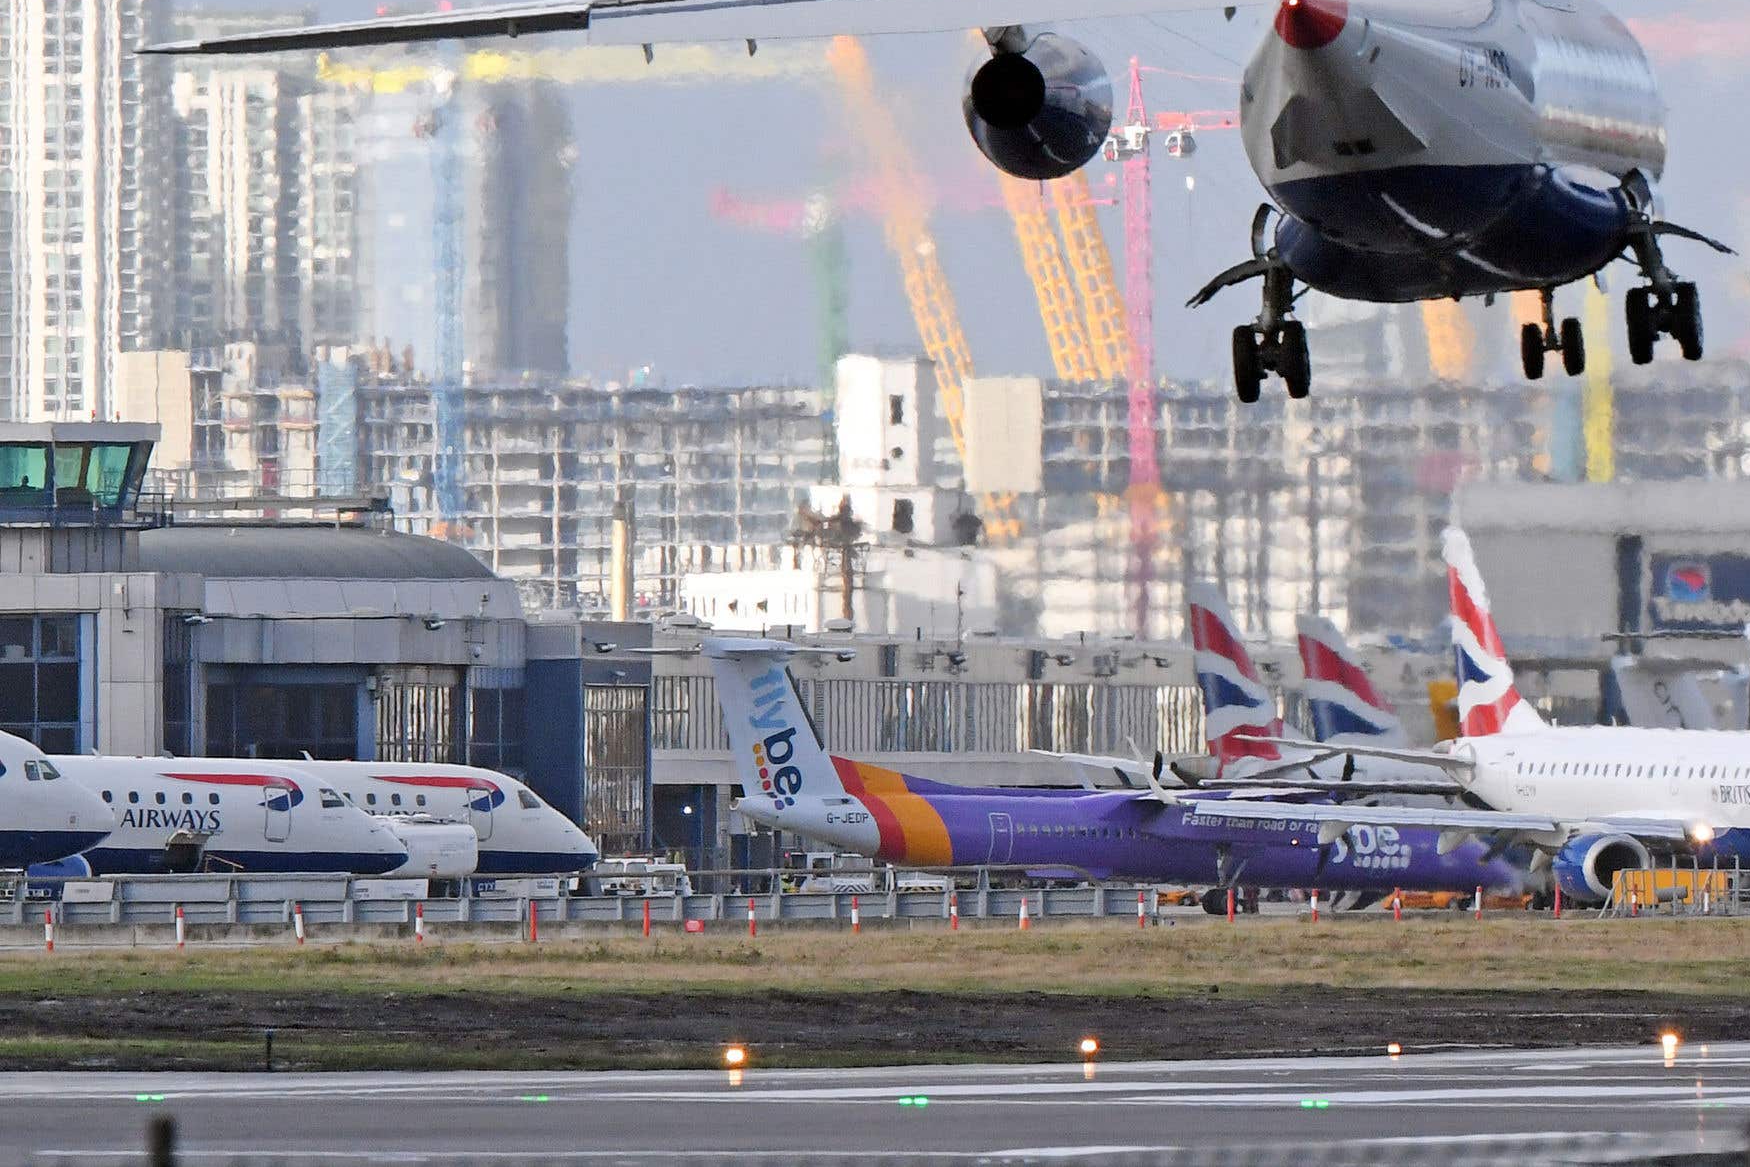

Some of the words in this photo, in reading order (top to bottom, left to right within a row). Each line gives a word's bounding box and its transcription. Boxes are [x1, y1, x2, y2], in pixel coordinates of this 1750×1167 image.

[120, 808, 221, 830] AIRWAYS
[826, 812, 870, 825] G-JEDP
[1182, 812, 1222, 827] Faster
[1289, 821, 1302, 832] or
